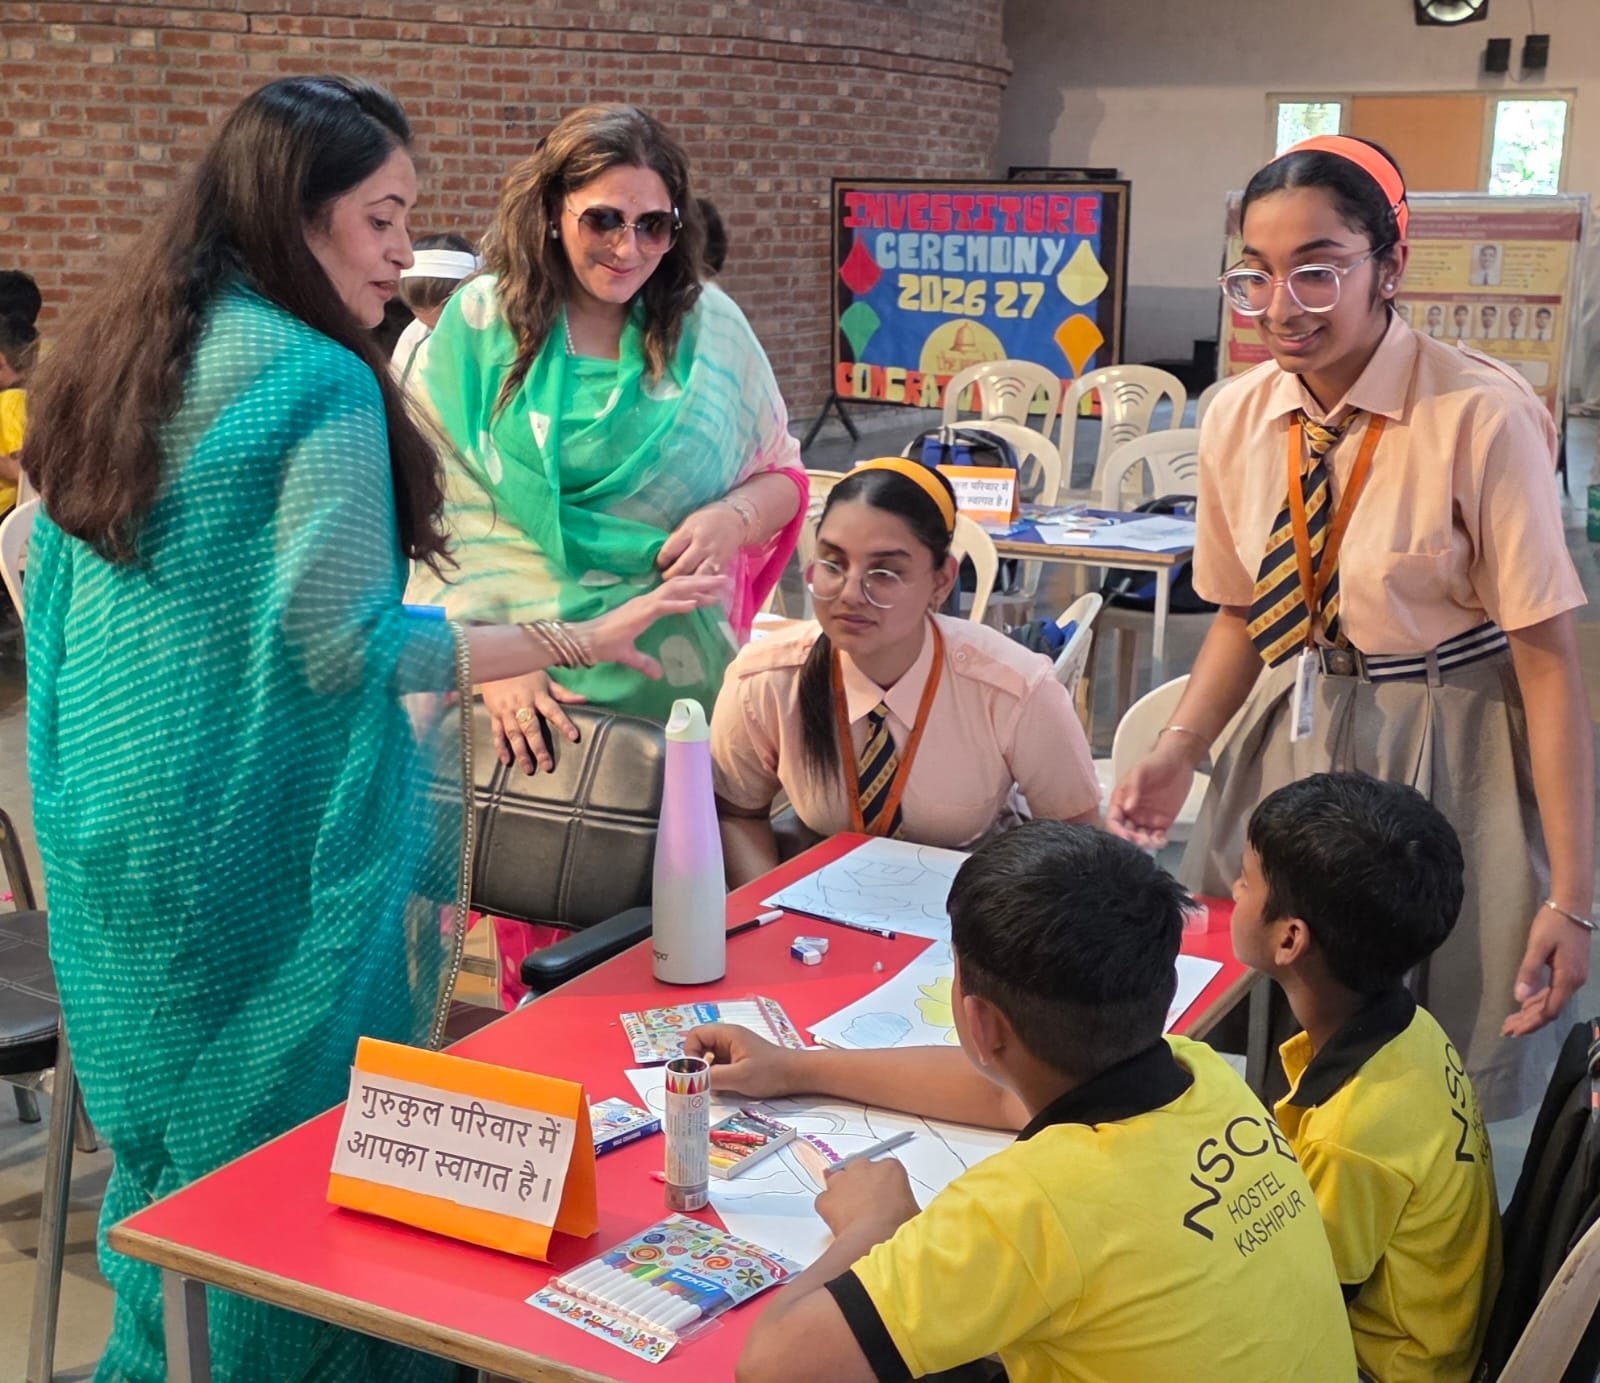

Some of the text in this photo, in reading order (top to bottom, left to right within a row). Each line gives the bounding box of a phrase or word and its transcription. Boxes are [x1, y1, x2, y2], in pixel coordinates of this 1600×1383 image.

[843, 191, 1098, 234] INVESTITURE
[875, 232, 1066, 276] CEREMONY
[898, 274, 1045, 319] 2026 27
[361, 1085, 444, 1128] गुरुकुल
[450, 1101, 532, 1148] परिवार
[538, 1117, 562, 1154] में
[347, 1130, 430, 1173] आपका
[435, 1149, 513, 1194] स्वागत
[1225, 1169, 1287, 1226] HOSTEL
[1232, 1187, 1307, 1259] KASHIPUR
